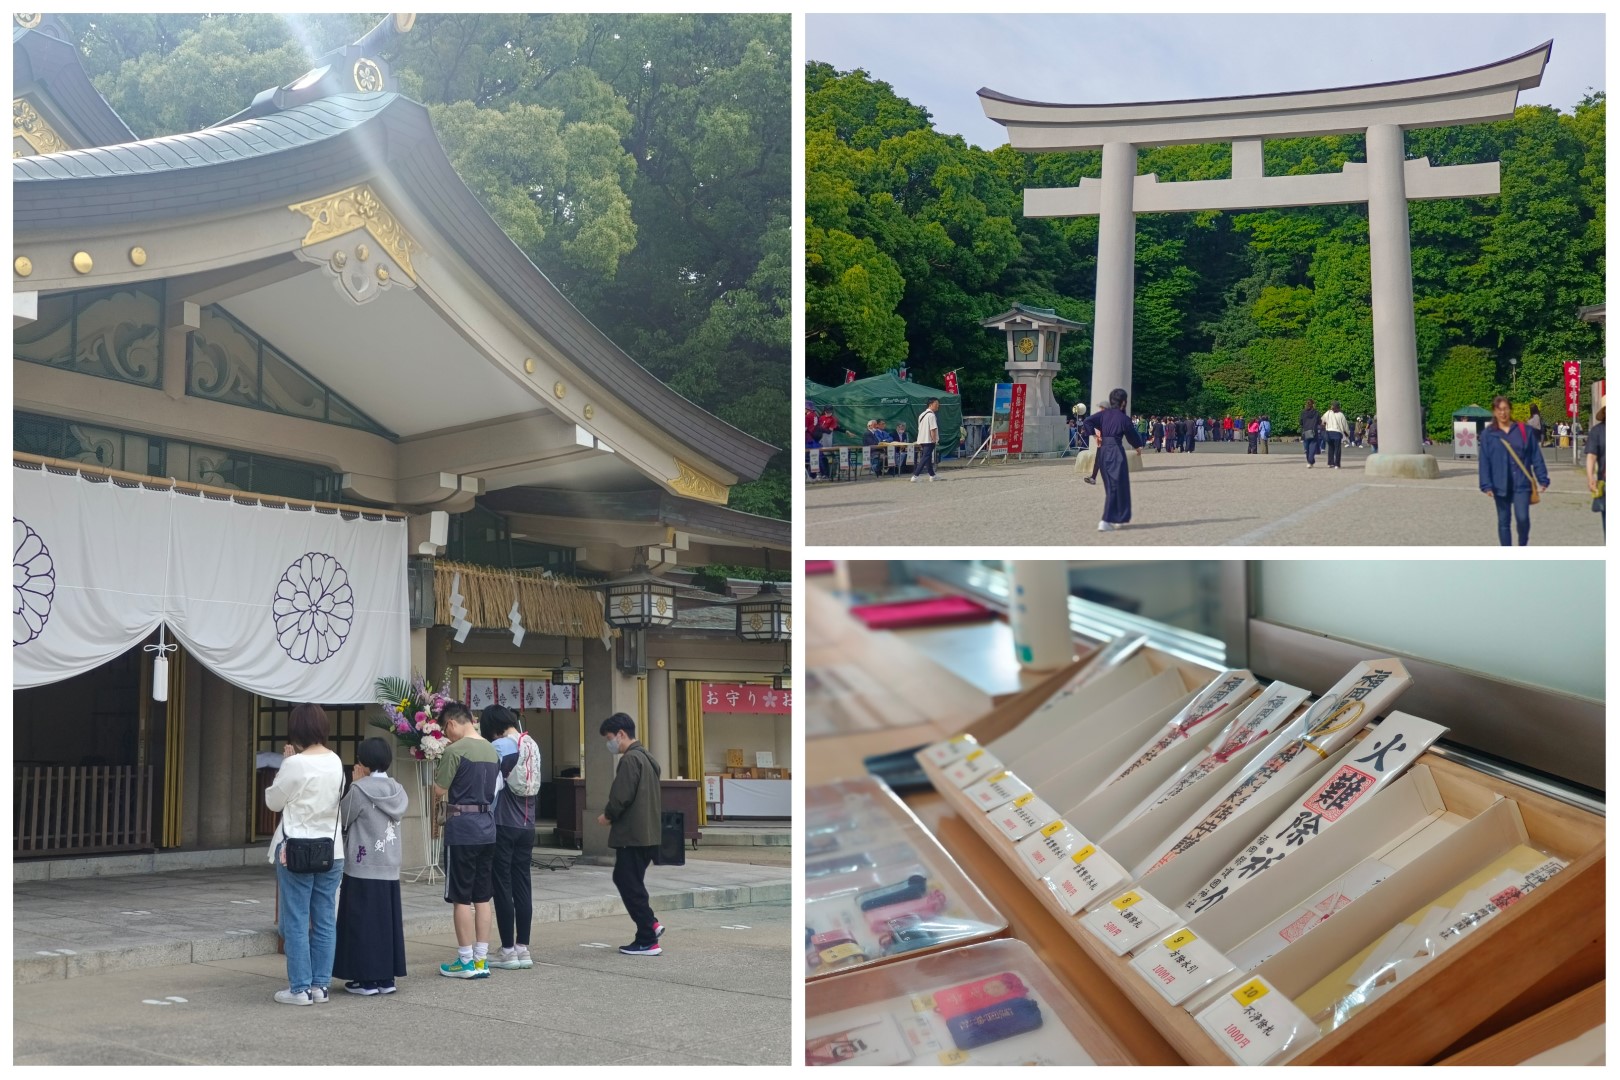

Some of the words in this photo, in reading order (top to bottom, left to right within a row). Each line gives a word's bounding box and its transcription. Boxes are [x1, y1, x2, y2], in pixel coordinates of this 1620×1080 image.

[706, 689, 756, 707] お守り
[1079, 849, 1089, 857] 7
[1103, 921, 1122, 937] 500円
[1173, 936, 1185, 944] 9
[1168, 949, 1199, 975] 方除水引
[1152, 963, 1176, 985] 1000円
[1243, 986, 1259, 998] 10
[1224, 1023, 1251, 1049] 1000円
